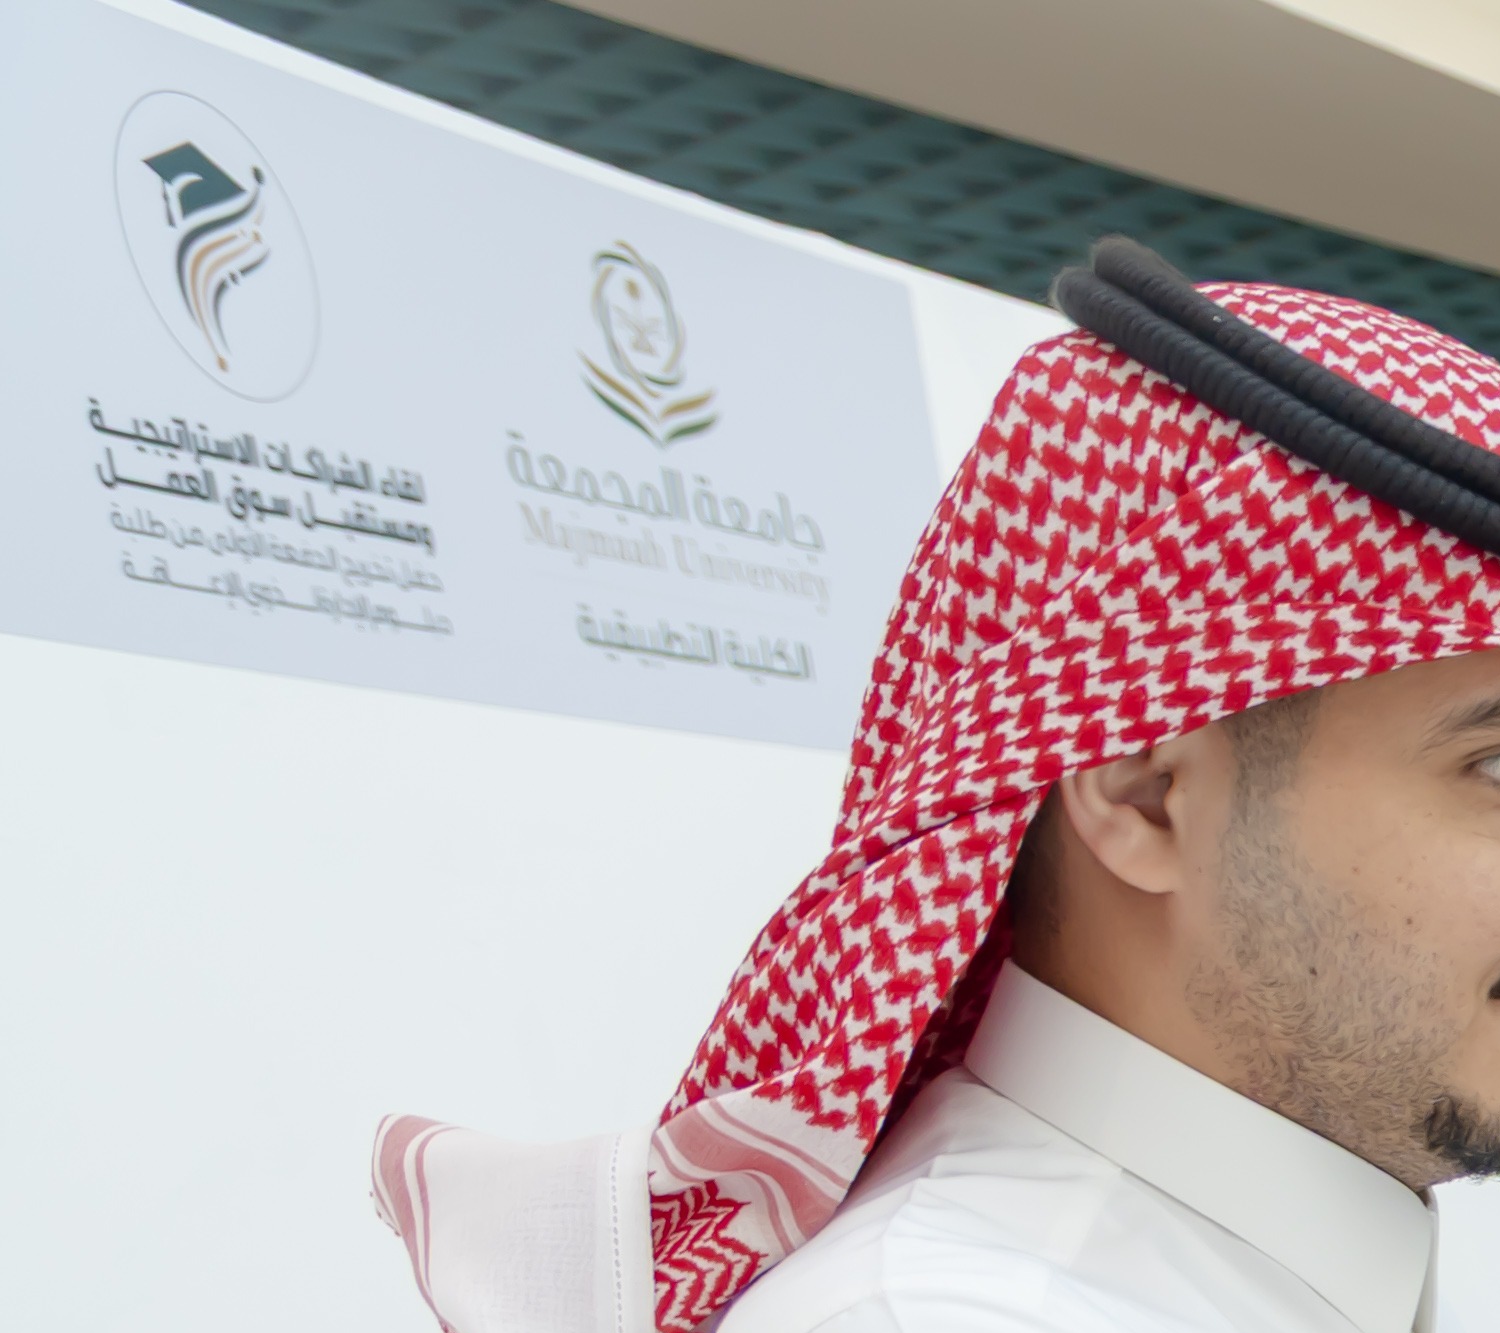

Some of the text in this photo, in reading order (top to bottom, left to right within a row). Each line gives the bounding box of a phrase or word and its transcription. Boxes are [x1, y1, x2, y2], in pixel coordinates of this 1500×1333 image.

[87, 397, 427, 504] لقاء الشراكات الاستراتيجية
[96, 447, 437, 557] ومستقبل سوق العمل
[504, 428, 826, 565] جامعة المجمعة
[574, 602, 819, 686] الكلية التطبيقية
